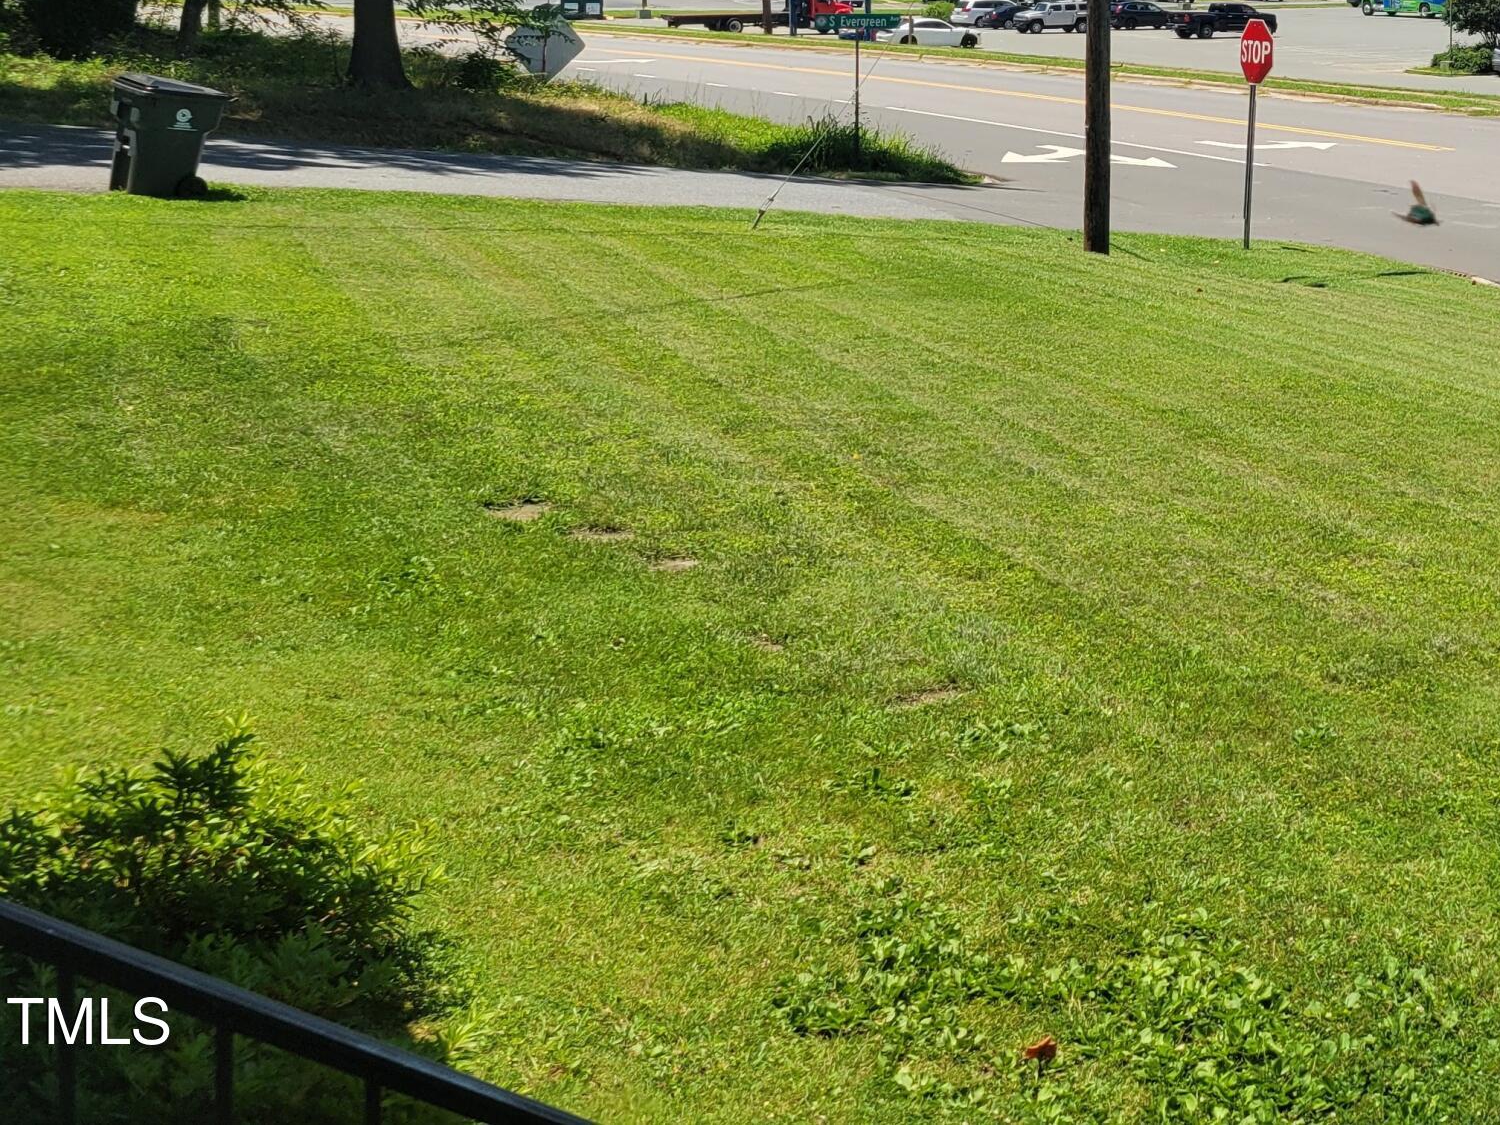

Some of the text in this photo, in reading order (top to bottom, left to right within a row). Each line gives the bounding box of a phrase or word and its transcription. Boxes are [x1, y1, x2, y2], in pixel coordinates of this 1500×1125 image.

[829, 15, 836, 27] S
[840, 16, 887, 28] Evergreen
[1241, 39, 1271, 64] STOP
